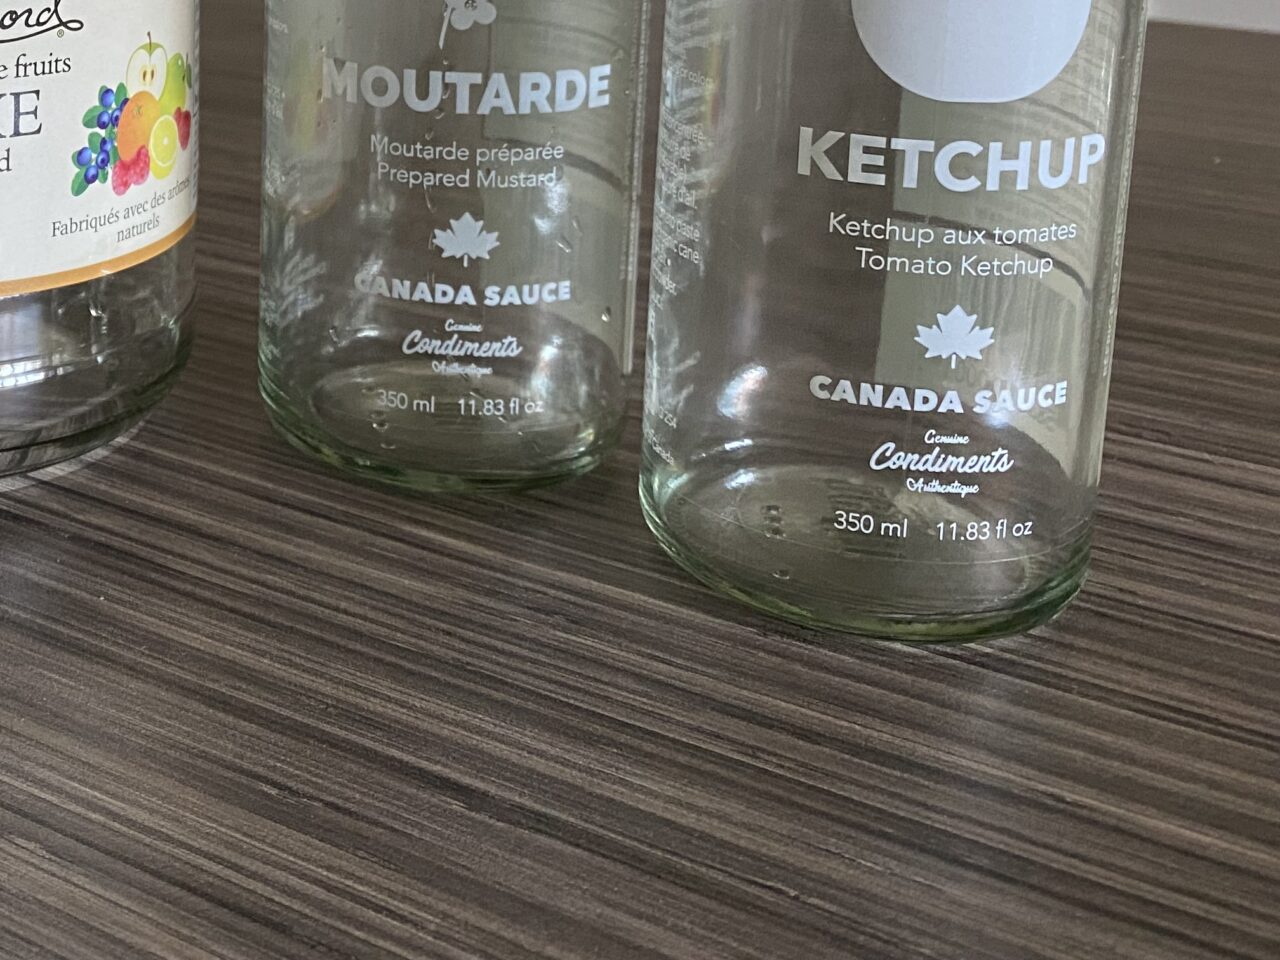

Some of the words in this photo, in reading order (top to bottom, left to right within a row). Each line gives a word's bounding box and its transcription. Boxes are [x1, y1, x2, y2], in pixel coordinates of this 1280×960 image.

[14, 51, 73, 79] fruits
[322, 57, 613, 116] MOUTARDE
[370, 134, 470, 161] Moutarde
[475, 141, 565, 166] préparée
[797, 125, 1106, 194] KETCHUP
[377, 162, 470, 188] Prepared
[476, 166, 558, 189] Mustard
[51, 208, 120, 238] Fabriqués
[123, 201, 149, 220] avec
[150, 191, 166, 210] des
[116, 213, 160, 243] naturels
[829, 212, 934, 247] Ketchup
[942, 226, 986, 245] aux
[993, 221, 1078, 244] tomates
[855, 246, 952, 276] Tomato
[960, 245, 1054, 279] Ketchup
[354, 274, 477, 306] CANADA
[483, 280, 572, 307] SAUCE
[401, 329, 523, 358] Condiments
[377, 389, 409, 410] 350
[413, 395, 435, 413] ml
[457, 398, 505, 416] 11.83
[508, 397, 520, 416] fl
[523, 400, 545, 414] oz
[809, 375, 964, 414] CANADA
[973, 380, 1068, 415] SAUCE
[869, 442, 1015, 474] Condiments
[834, 510, 875, 534] 350
[880, 517, 908, 539] ml
[936, 520, 991, 541] 11.83
[995, 518, 1008, 540] fl
[1011, 521, 1034, 538] oz
